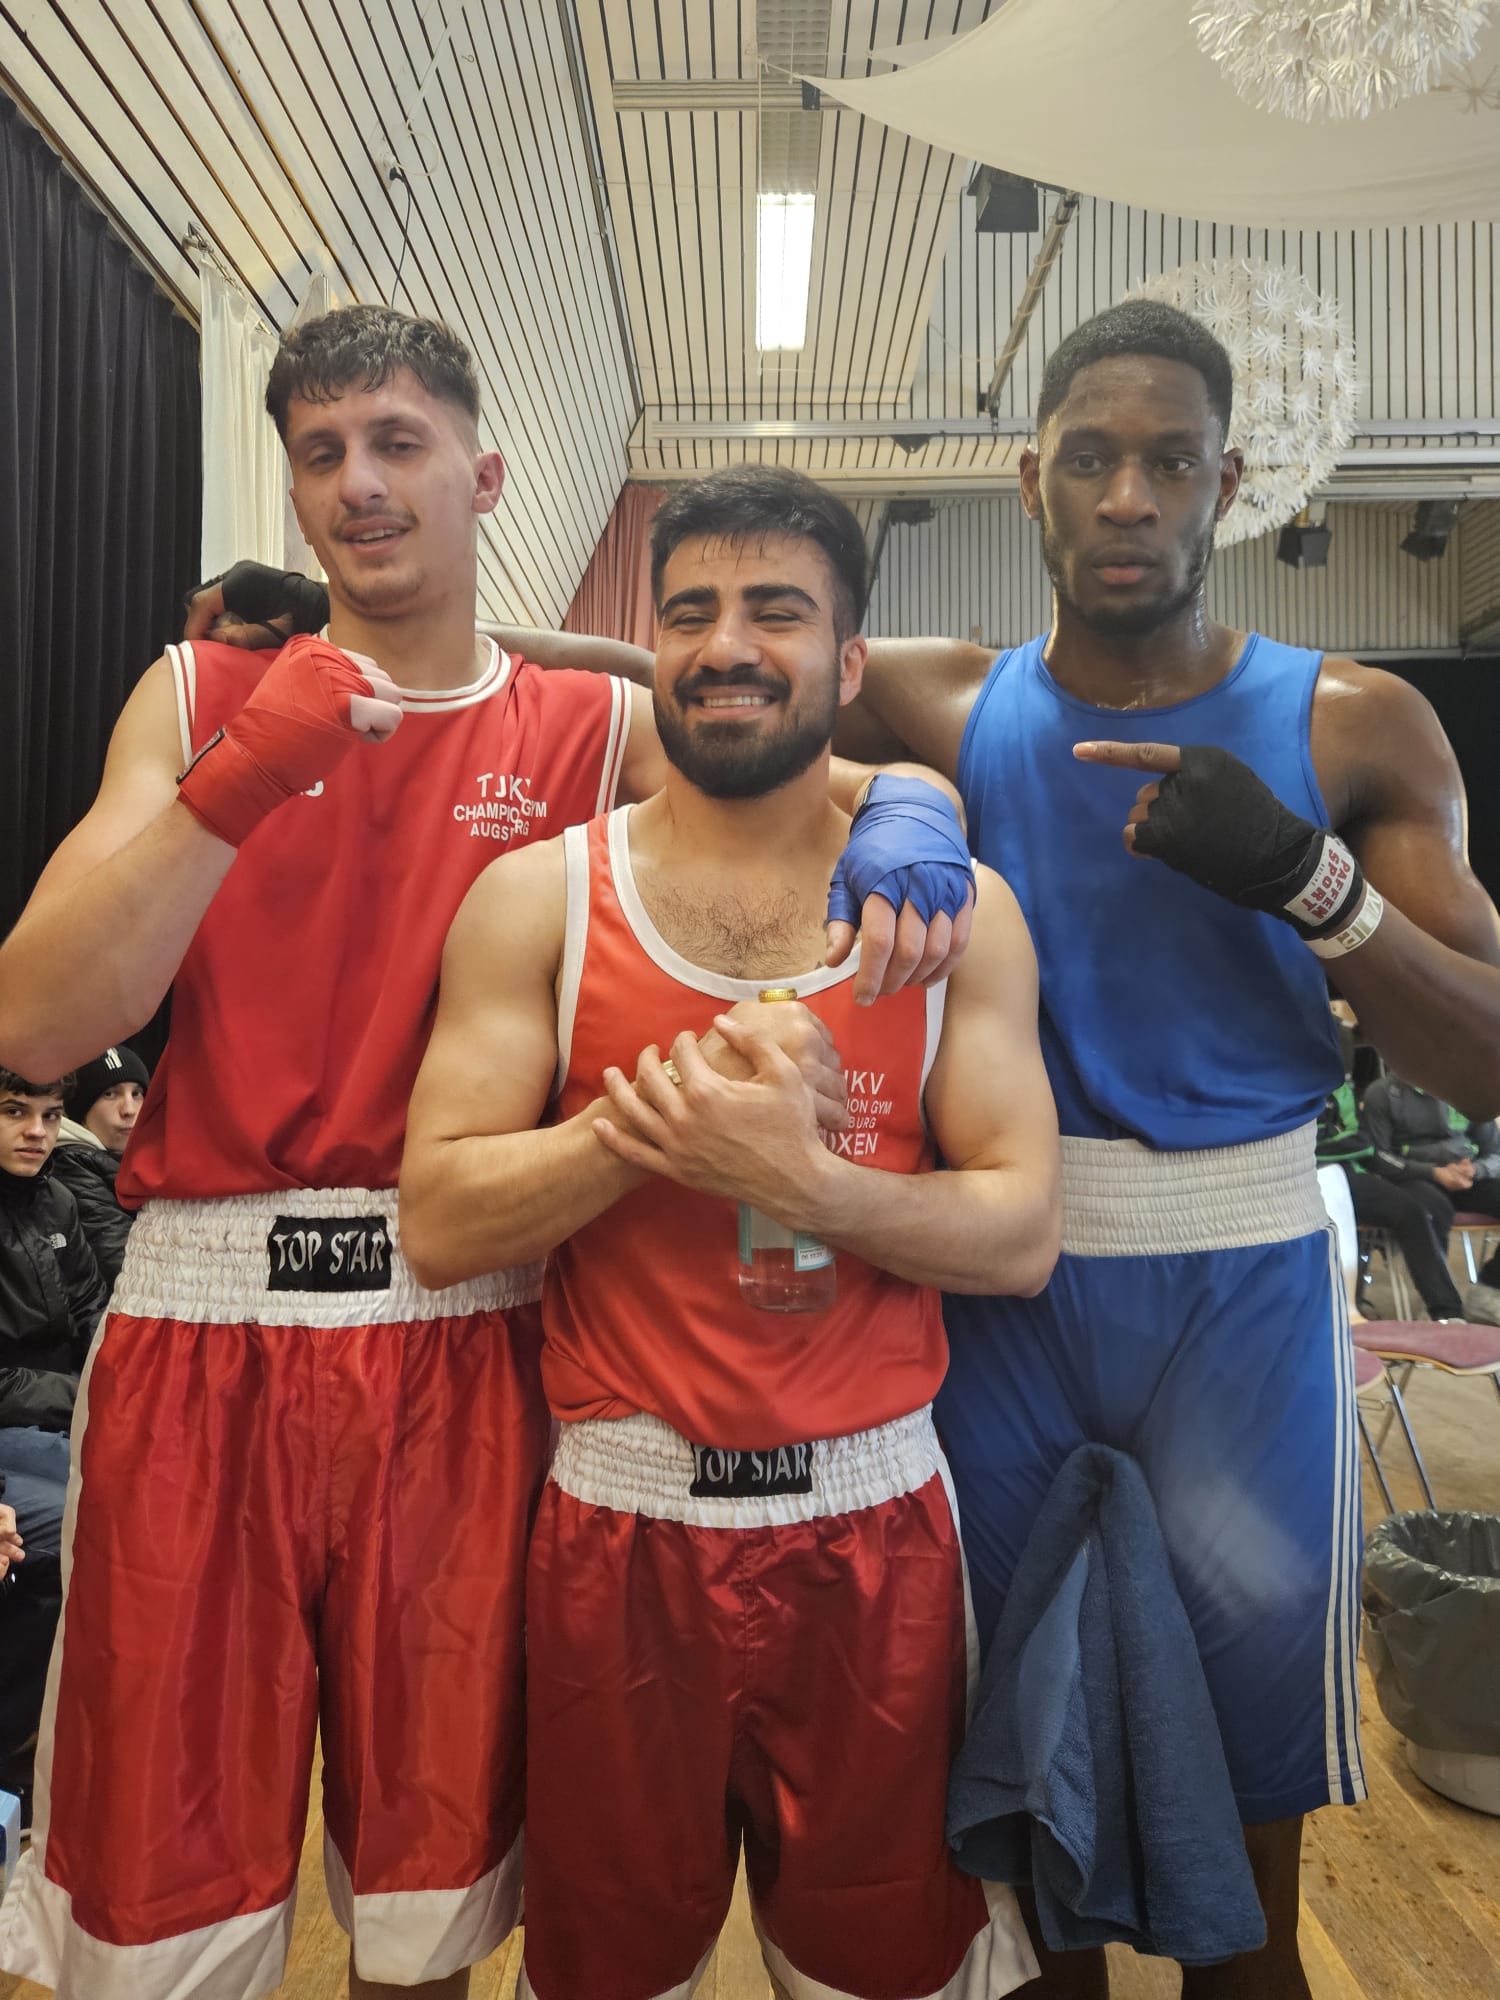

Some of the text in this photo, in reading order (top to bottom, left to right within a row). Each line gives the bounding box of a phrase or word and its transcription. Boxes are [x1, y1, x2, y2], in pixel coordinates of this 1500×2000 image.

[476, 772, 531, 802] TJK
[453, 801, 520, 823] CHAMPIO
[1301, 849, 1340, 911] SPORT
[1311, 859, 1351, 920] PAFFEN
[844, 1069, 885, 1095] KV
[870, 1100, 893, 1115] GYM
[272, 1228, 386, 1275] TOP STAR
